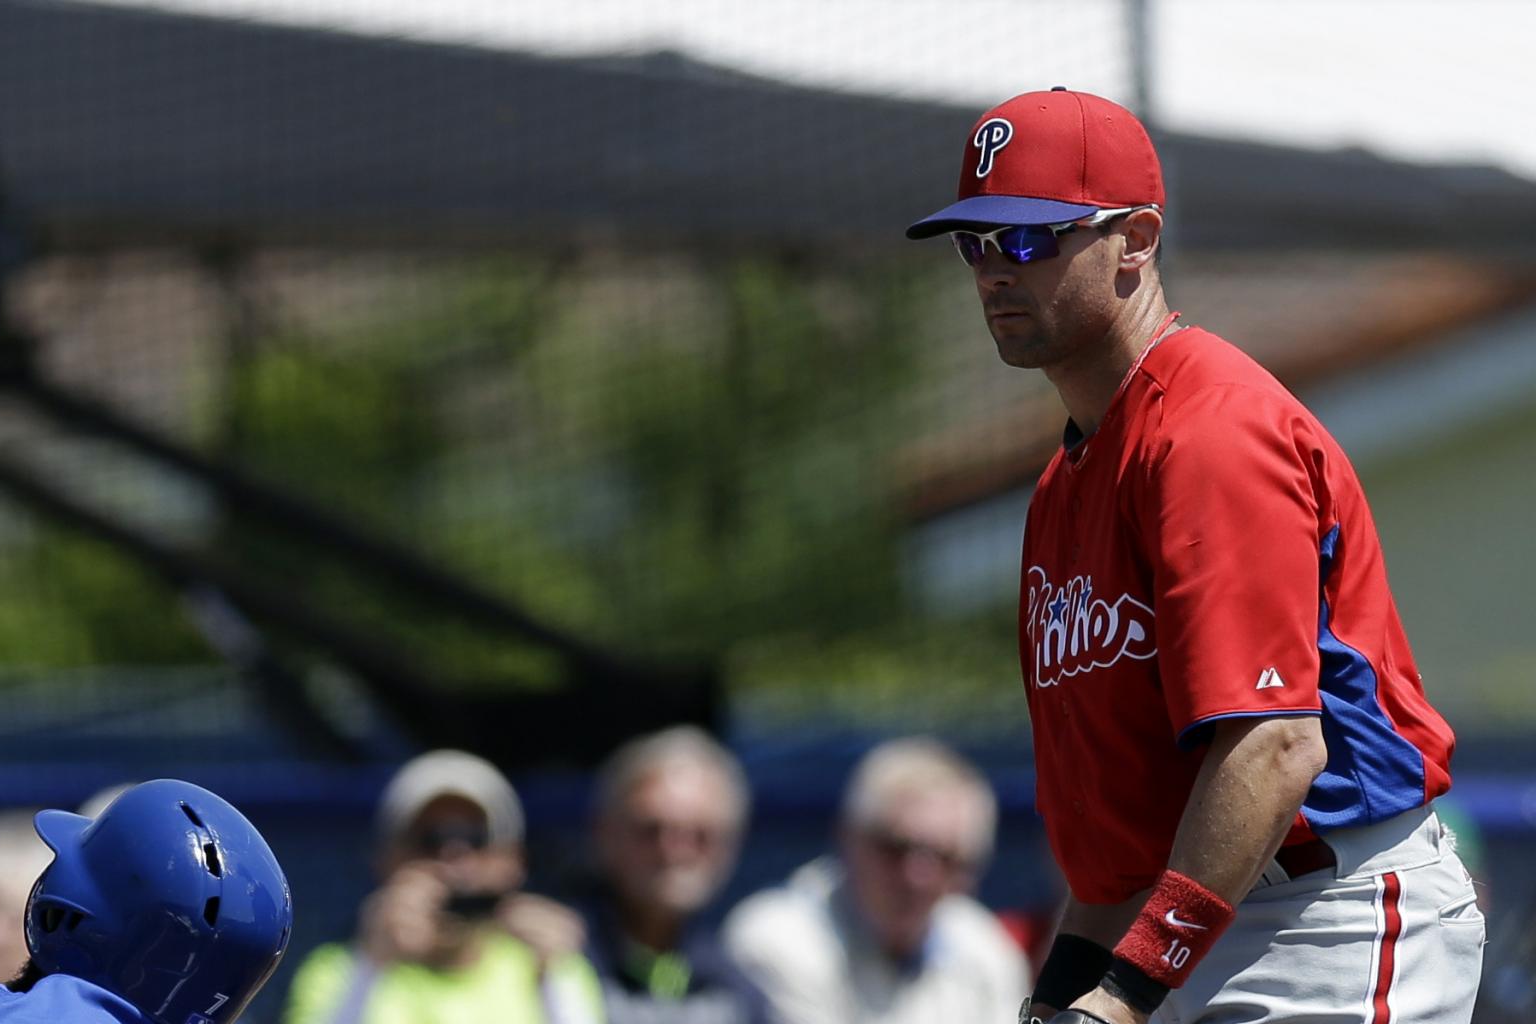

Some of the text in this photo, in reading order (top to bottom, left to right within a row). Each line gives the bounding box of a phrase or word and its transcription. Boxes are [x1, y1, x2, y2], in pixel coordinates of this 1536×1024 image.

[974, 118, 1013, 178] P
[1161, 939, 1191, 969] 10
[204, 993, 229, 1015] 7
